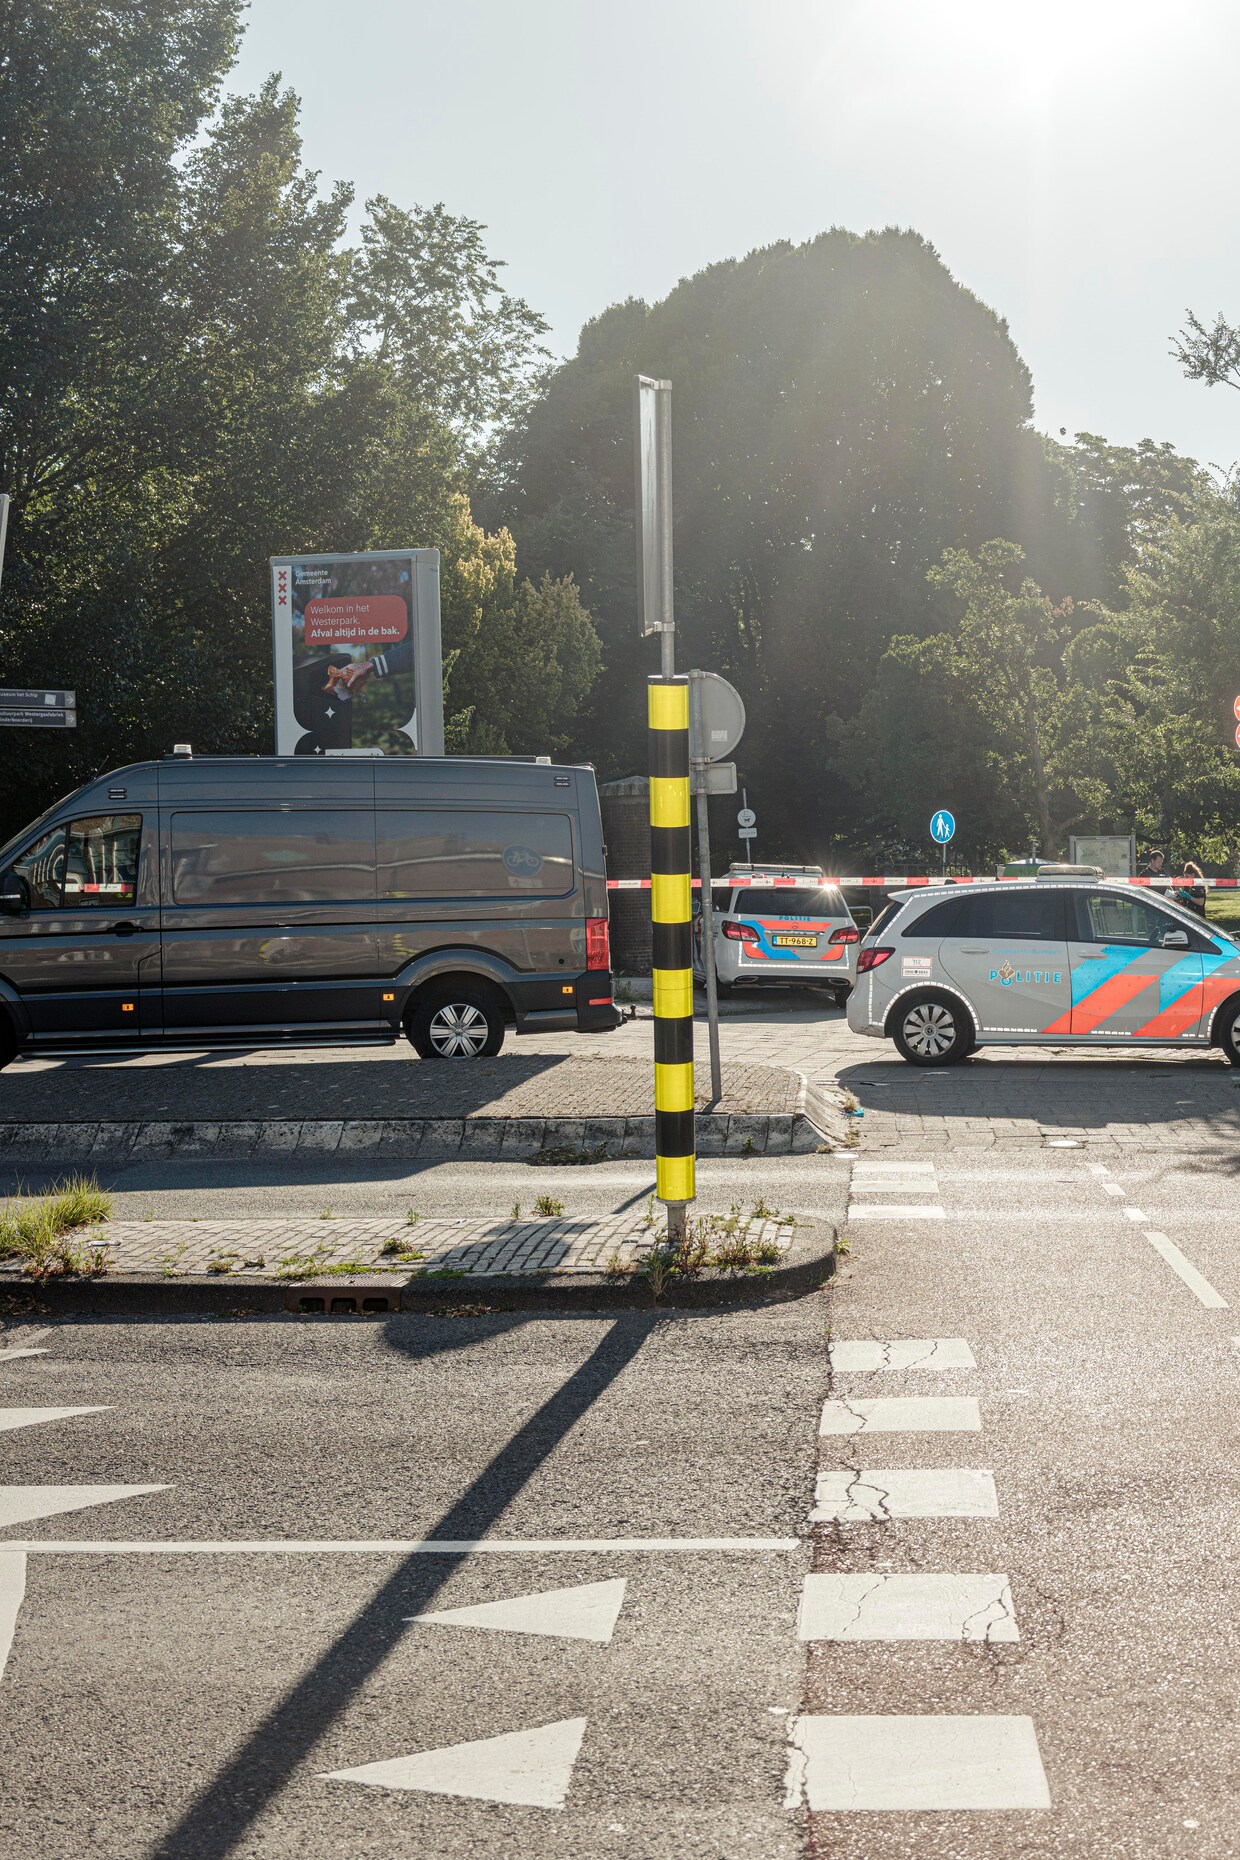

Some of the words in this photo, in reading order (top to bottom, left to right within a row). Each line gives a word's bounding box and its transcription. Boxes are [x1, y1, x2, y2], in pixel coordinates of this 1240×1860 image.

[295, 569, 329, 577] Gemeente
[310, 605, 344, 614] Welkom
[346, 605, 354, 613] in
[355, 604, 370, 613] het
[310, 616, 360, 626] Westerpark.
[311, 628, 333, 638] Afval
[334, 627, 356, 638] altijd
[358, 627, 366, 636] in
[368, 626, 379, 636] de
[381, 626, 400, 635] bak.
[780, 937, 814, 945] TT-968-Z
[989, 969, 1062, 986] POLITIE
